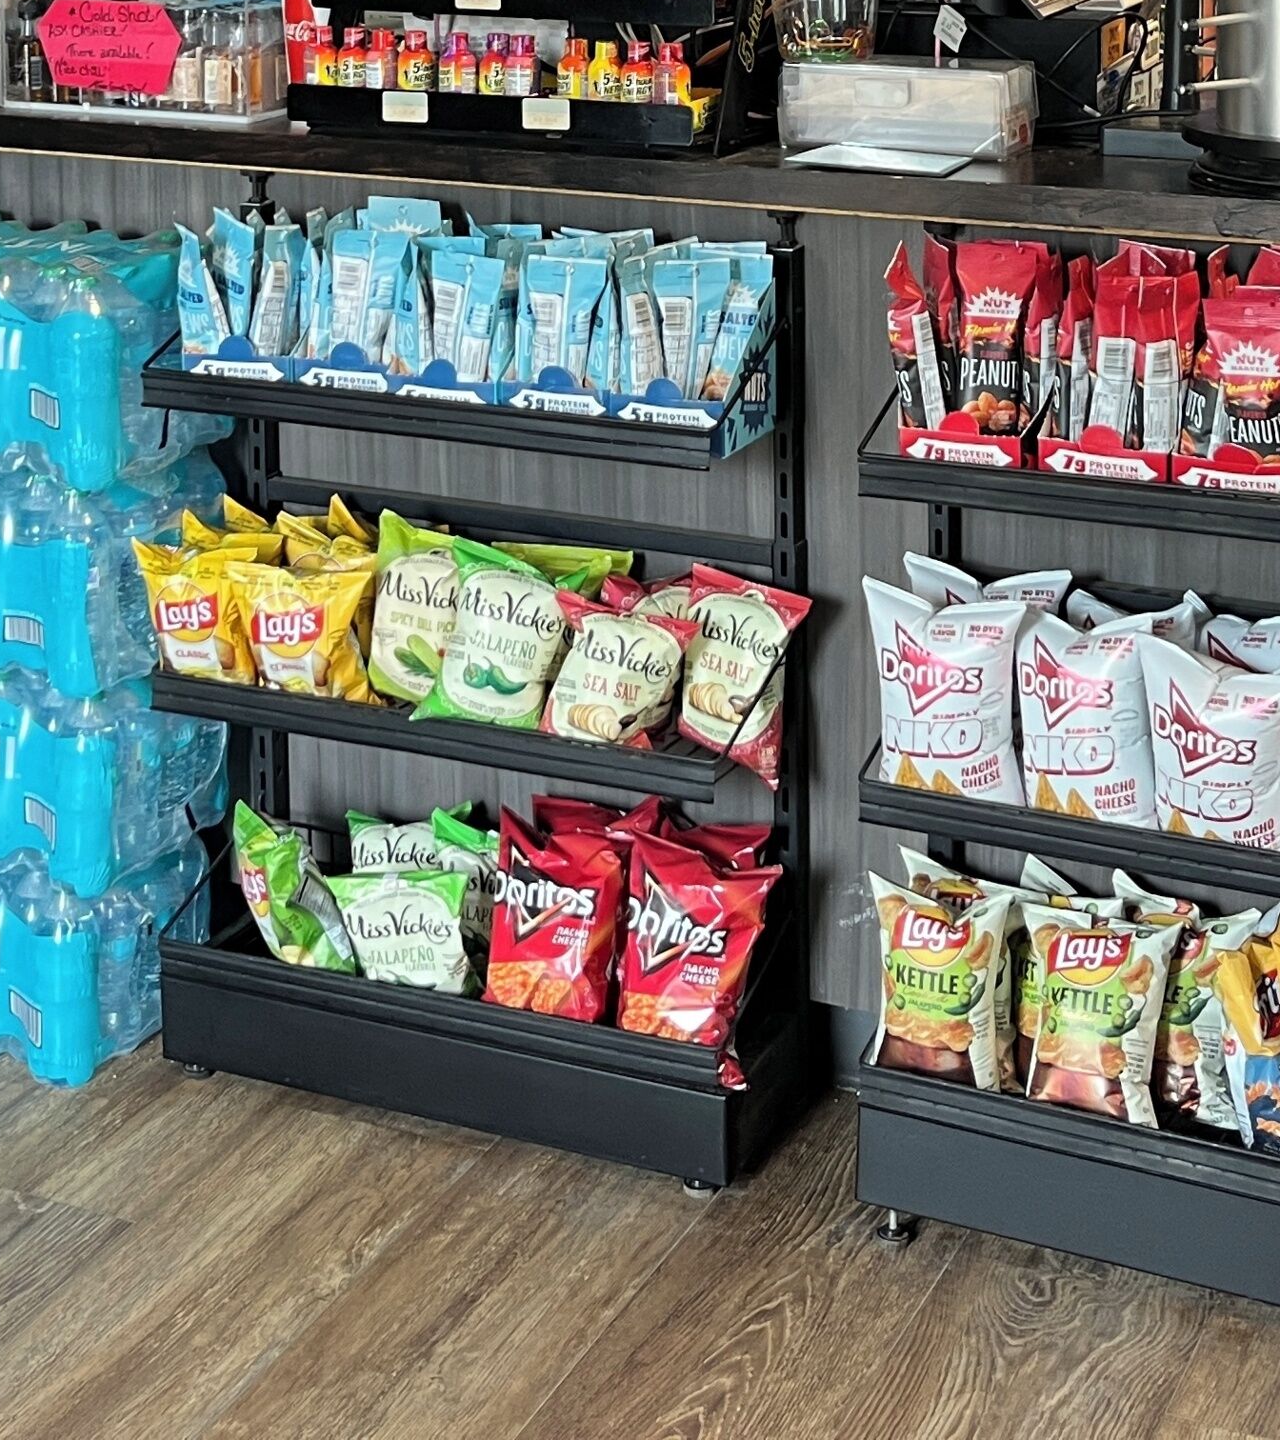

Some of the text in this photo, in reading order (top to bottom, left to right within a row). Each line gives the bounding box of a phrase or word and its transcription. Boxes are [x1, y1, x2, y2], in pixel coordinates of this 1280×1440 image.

[79, 1, 115, 23] Cold
[983, 296, 1011, 308] NUT
[228, 366, 269, 376] PROTEIN
[1236, 354, 1265, 366] NUT
[337, 376, 378, 386] PROTEIN
[547, 398, 590, 410] PROTEIN
[656, 411, 701, 424] PROTEIN
[948, 448, 995, 460] PROTEIN
[1089, 460, 1139, 474] PROTEIN
[1224, 477, 1277, 492] PROTEIN
[379, 571, 421, 603] Miss
[159, 596, 214, 632] Lay's
[390, 611, 413, 627] SPICY
[460, 587, 566, 641] Miss Vickie's
[257, 610, 319, 645] Lay's
[729, 614, 784, 665] Vickie's
[176, 648, 212, 662] CLASSIC
[469, 630, 537, 660] JALAPEÑO
[617, 635, 672, 683] Vickie's
[700, 652, 754, 683] SEA SALT
[882, 647, 983, 694] Doritos
[583, 673, 641, 702] SEA SALT
[1020, 660, 1114, 709] Doritos
[884, 714, 984, 759] NKD
[1154, 702, 1258, 764] Doritos
[961, 754, 999, 778] NACHO
[1025, 734, 1116, 775] NKD
[961, 767, 1002, 790] CHEESE
[1094, 778, 1136, 798] NACHO
[1094, 790, 1138, 811] CHEESE
[1158, 771, 1254, 823] NKD
[1233, 818, 1276, 842] NACHO
[347, 903, 455, 942] Miss Vickie's
[556, 925, 590, 938] NACHO
[552, 935, 587, 948] CHEESE
[1057, 931, 1124, 970] Lay's
[679, 972, 718, 987] CHEESE
[684, 962, 720, 976] NACHO
[896, 963, 960, 996] KETTLE
[1049, 985, 1115, 1016] KETTLE
